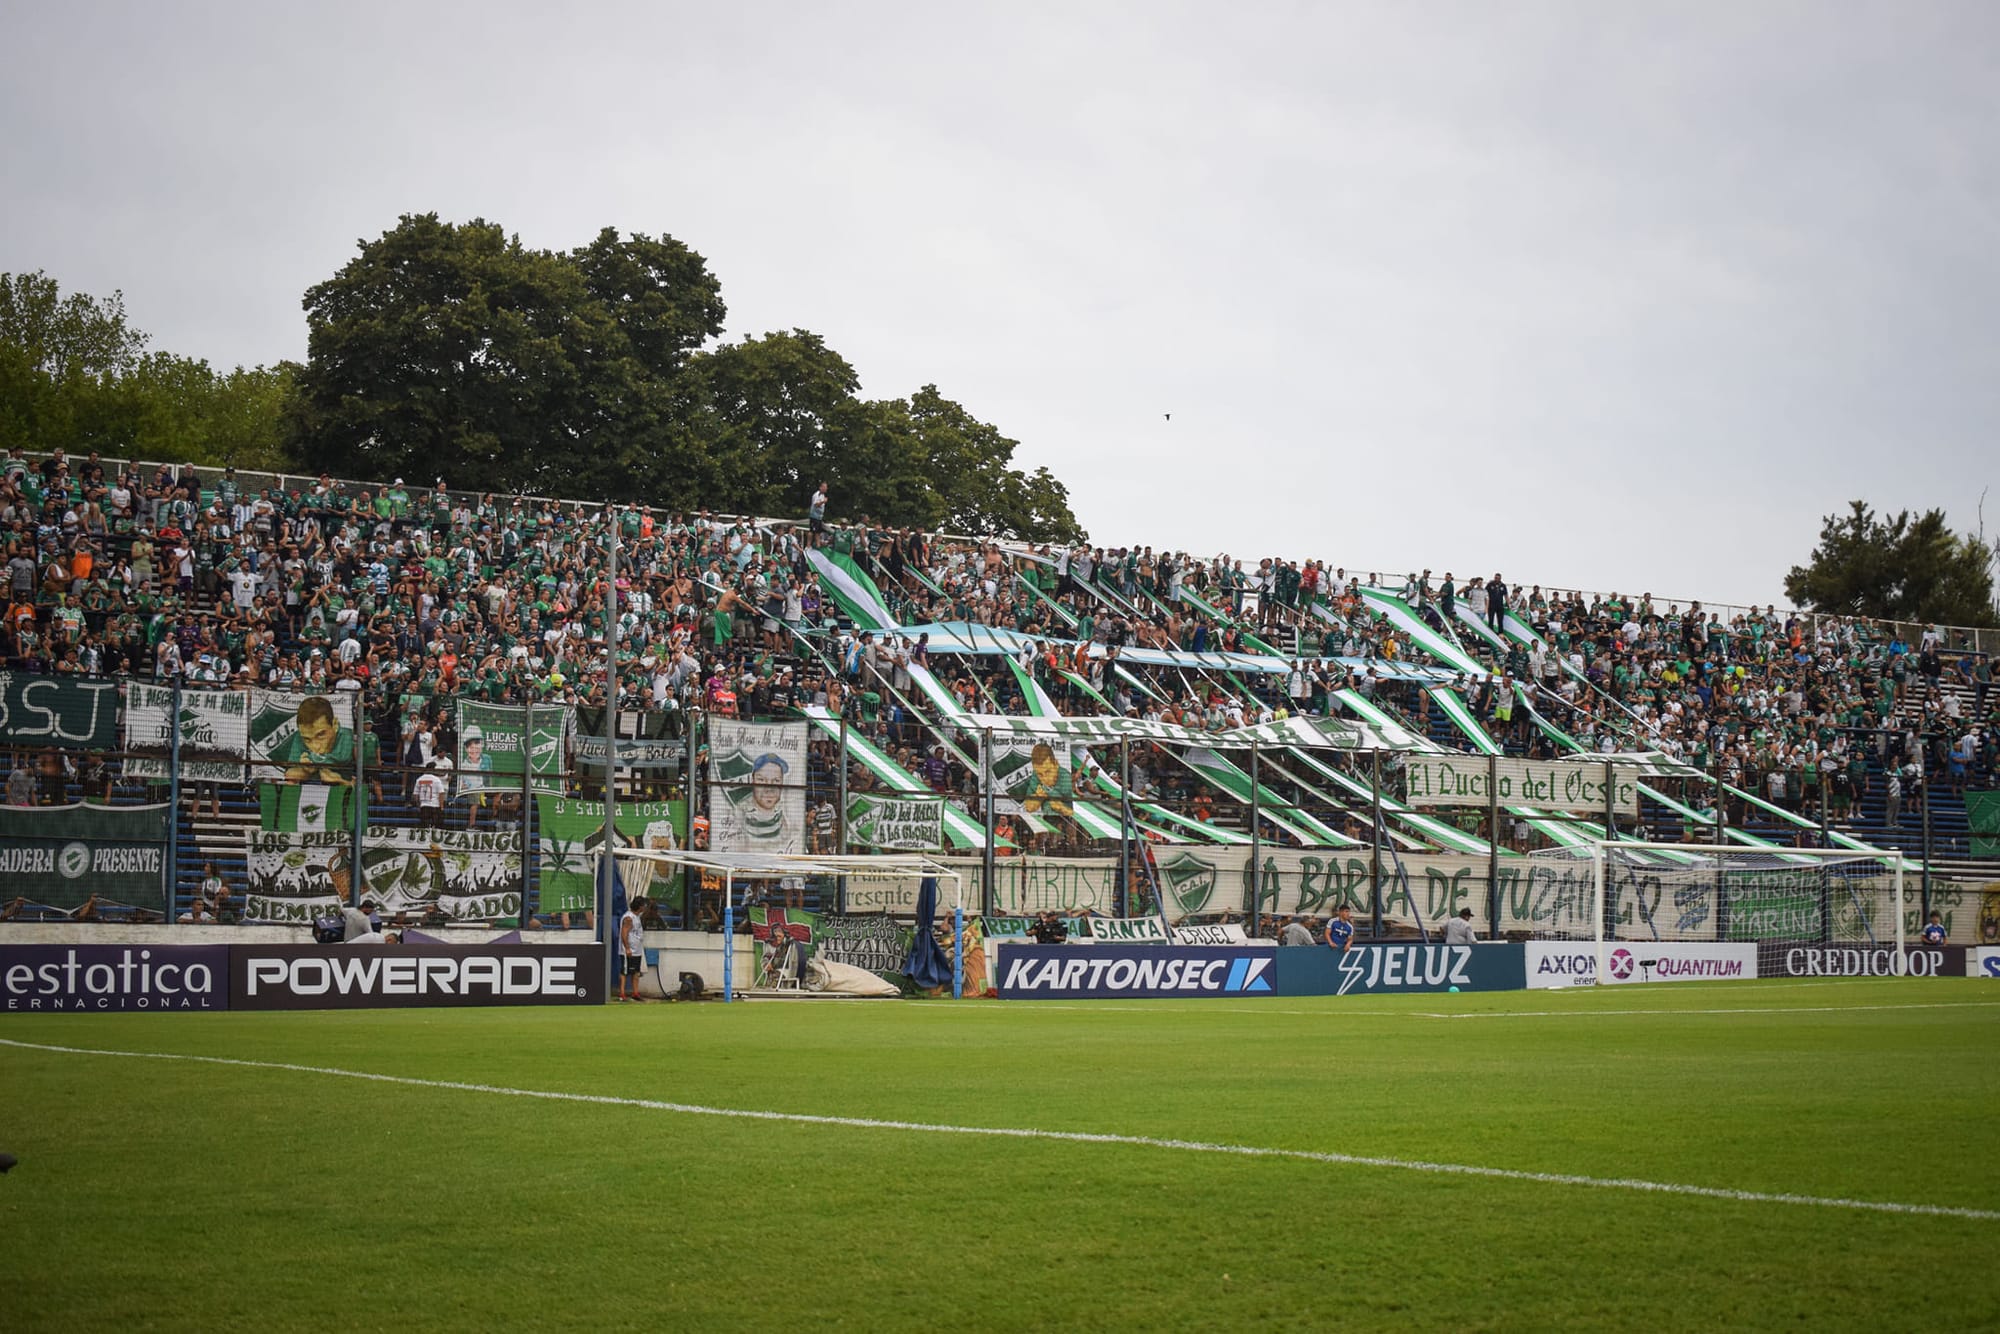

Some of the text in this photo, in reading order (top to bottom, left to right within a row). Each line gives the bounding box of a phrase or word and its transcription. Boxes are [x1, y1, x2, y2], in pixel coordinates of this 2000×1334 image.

[486, 732, 518, 743] LUCAS
[1409, 763, 1430, 797] El
[1522, 768, 1555, 801] del
[576, 802, 623, 817] sana
[883, 802, 897, 820] DE
[913, 803, 940, 822] NADA
[251, 829, 353, 854] LOS PIBE
[371, 826, 399, 838] DE
[902, 823, 939, 845] GLORIA
[93, 848, 160, 873] PRESENTE
[453, 893, 521, 919] LADO
[1425, 866, 1472, 921] DE
[246, 896, 342, 921] SIEMPR
[1094, 920, 1161, 941] SANTA
[5, 949, 213, 994] estatica
[1003, 958, 1227, 991] KARTONSEC
[1365, 945, 1472, 989] JELUZ
[1656, 957, 1742, 977] QUANTIUM
[1786, 948, 1944, 977] CREDICOOP
[247, 956, 577, 996] POWERADE
[8, 998, 210, 1009] ERNACIONAL
